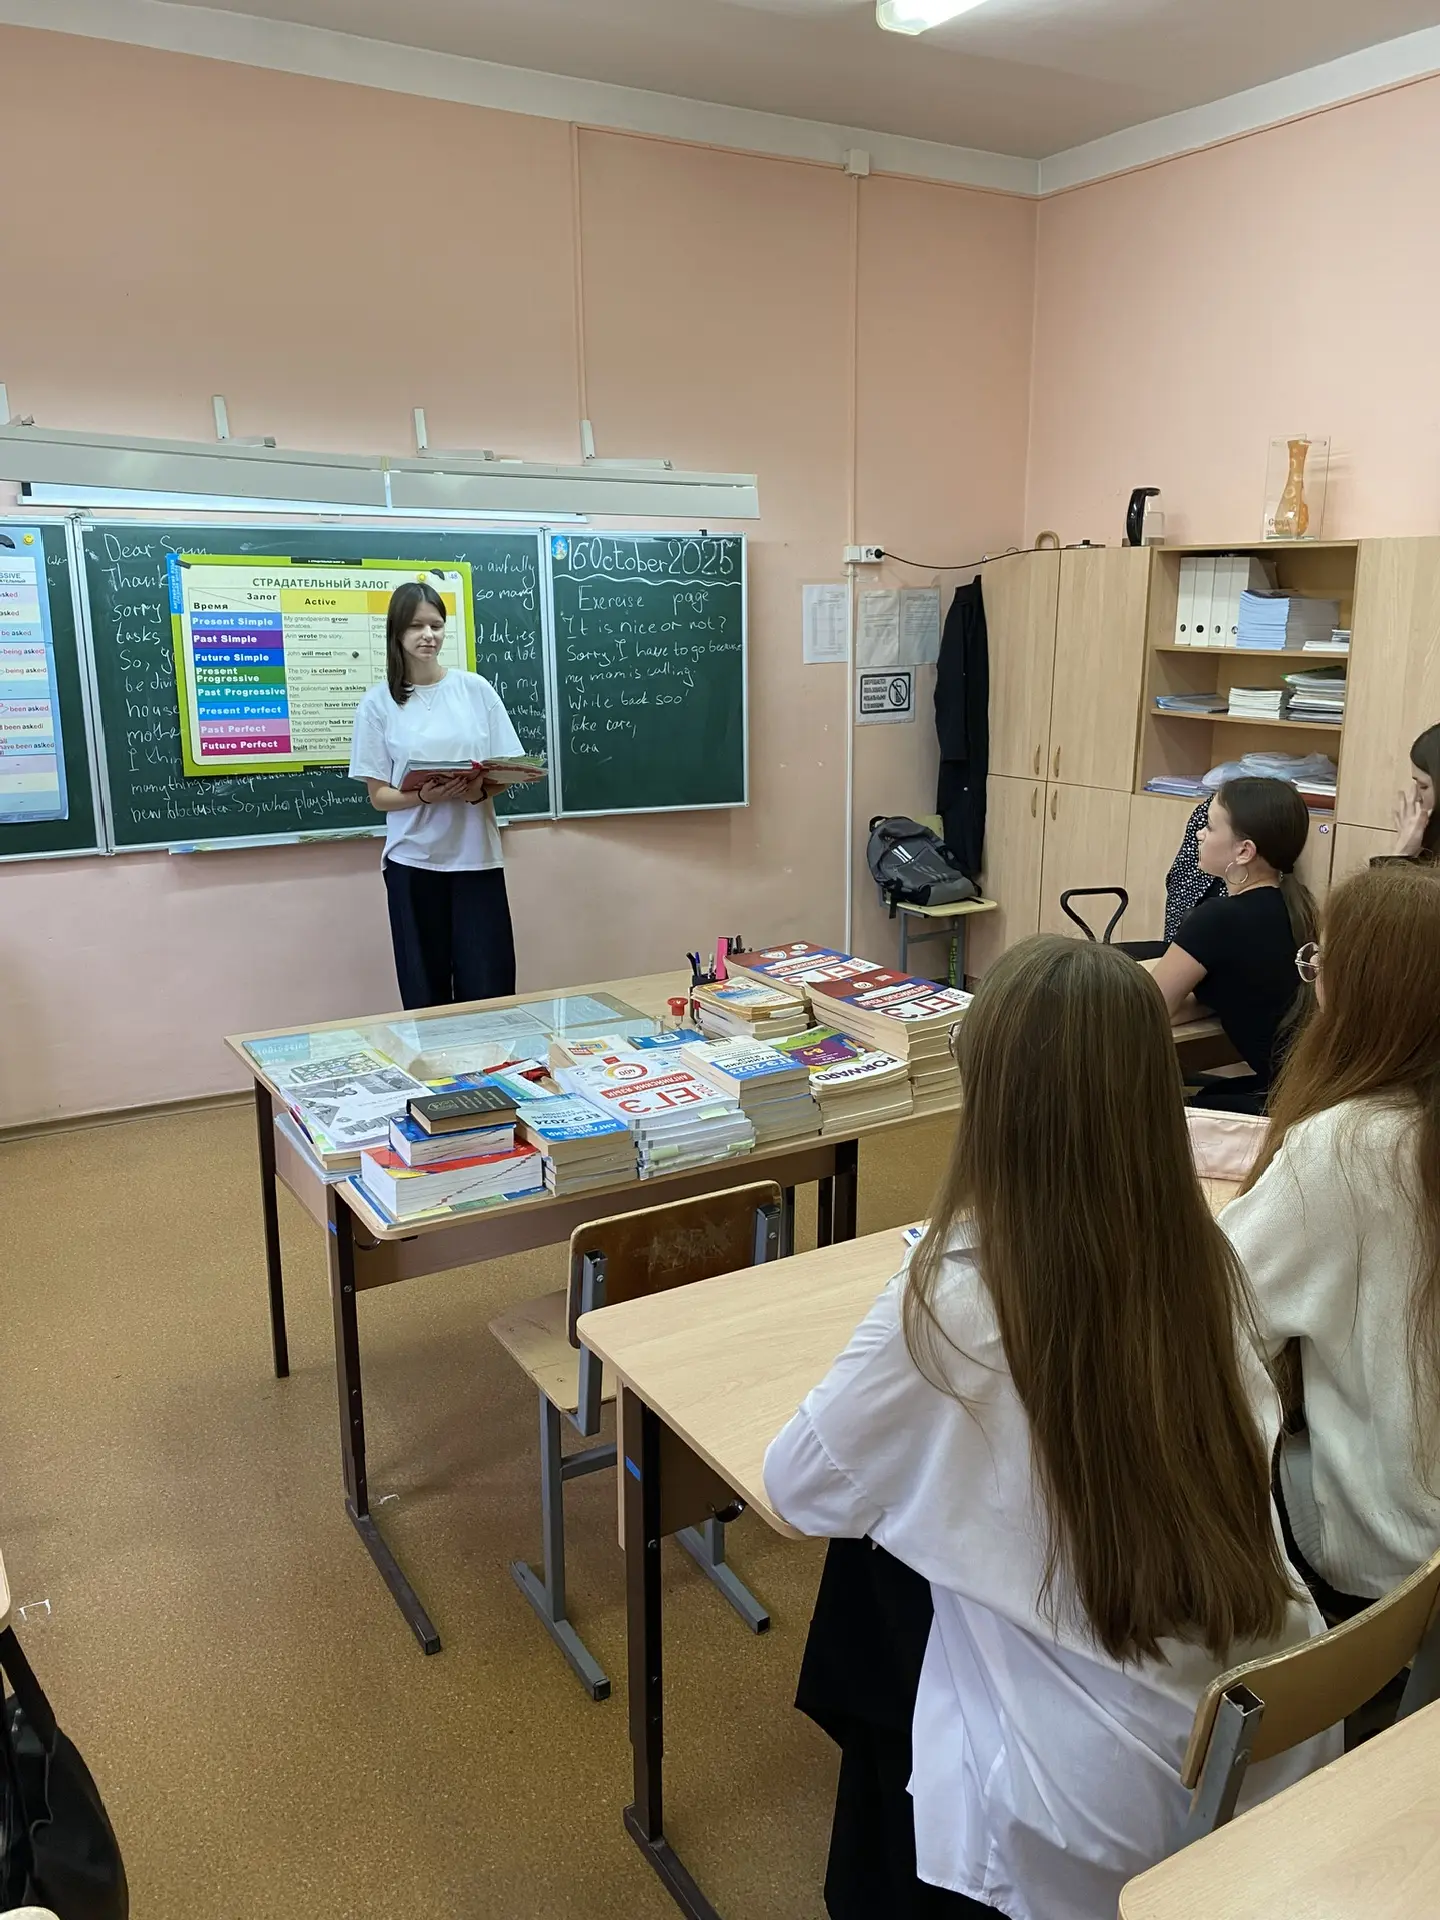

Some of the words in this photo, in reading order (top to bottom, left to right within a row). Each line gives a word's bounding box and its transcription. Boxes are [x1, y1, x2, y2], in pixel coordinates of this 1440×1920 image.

[103, 533, 156, 562] Dear
[590, 537, 668, 572] October
[252, 577, 351, 589] СТРАДАТЕЛЬНЫЙ
[355, 579, 389, 590] ЗАЛОГ
[246, 592, 278, 601] Залог
[304, 598, 337, 606] Active
[476, 589, 494, 601] so
[578, 585, 644, 611] Exercise
[673, 589, 709, 616] page
[112, 603, 162, 624] sorry
[193, 602, 229, 611] Время
[192, 617, 234, 626] Present
[238, 617, 274, 627] Simple
[599, 620, 613, 634] is
[620, 619, 656, 634] nice
[661, 622, 682, 632] or
[116, 622, 161, 645] tasks
[193, 634, 218, 644] Past
[221, 635, 258, 645] Simple
[489, 619, 536, 648] duties
[3, 648, 23, 656] being
[195, 654, 231, 662] Future
[234, 654, 270, 663] Simple
[636, 641, 668, 657] have
[673, 641, 688, 656] to
[692, 646, 706, 663] go
[196, 667, 238, 675] Present
[125, 675, 144, 692] be
[150, 671, 178, 690] divi
[197, 674, 260, 684] Progressive
[565, 674, 585, 693] my
[629, 665, 642, 679] is
[198, 688, 221, 697] Past
[224, 687, 286, 697] Progressive
[345, 684, 366, 692] asking
[517, 678, 539, 702] my
[568, 694, 613, 710] Write
[620, 690, 649, 706] back
[199, 707, 241, 715] Present
[244, 706, 282, 714] Perfect
[127, 721, 182, 746] mothe
[200, 726, 225, 734] Past
[228, 724, 266, 733] Perfect
[202, 742, 237, 750] Future
[240, 740, 278, 749] Perfect
[145, 745, 182, 765] thin
[879, 996, 963, 1019] ЕГЭ
[814, 1056, 898, 1081] FORWARD
[634, 1073, 689, 1091] АНГЛИЙСКИЙ
[606, 1086, 633, 1098] ЯЗЫК
[618, 1086, 703, 1113] ЕГЭ
[534, 1113, 601, 1125] ЕГЭ-2024
[545, 1122, 618, 1137] АНГЛИЙСКИЙ
